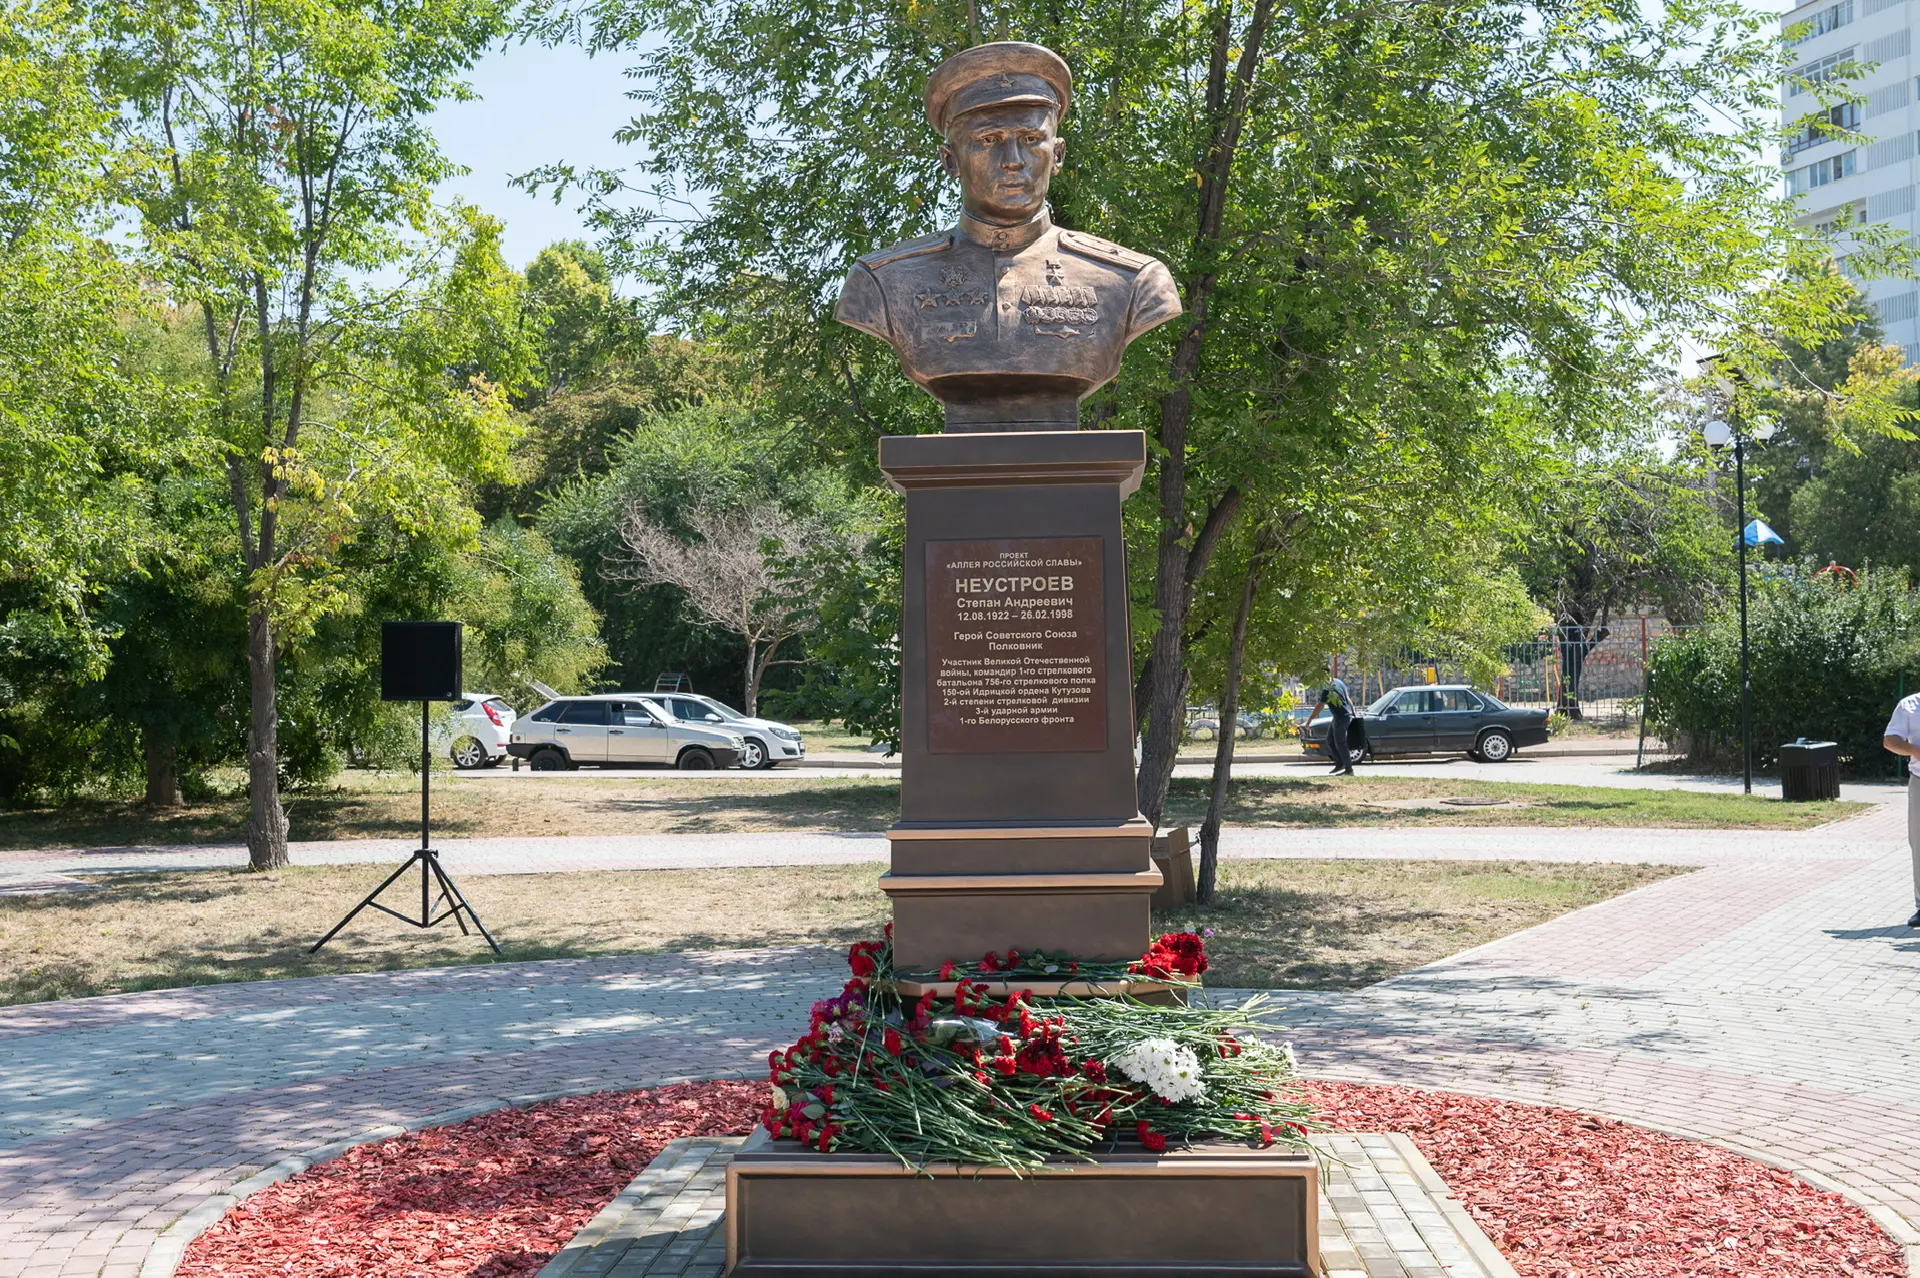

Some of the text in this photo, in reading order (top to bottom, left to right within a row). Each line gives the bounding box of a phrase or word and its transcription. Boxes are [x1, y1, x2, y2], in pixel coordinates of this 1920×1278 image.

[983, 559, 1044, 568] РОССИЙСКОЙ
[955, 576, 1074, 593] НЕУСТРОЕВ
[957, 597, 1073, 609] Степан Андреевич
[958, 611, 1009, 621] 12.08.1922
[1021, 609, 1073, 620] 26.02.1998
[954, 630, 1077, 642] Герой Советского Союза
[989, 642, 1043, 650] Полковник
[942, 656, 1090, 666] Участник Великой Отечественной
[940, 667, 1092, 677] войны, командир 1-го стрелкового
[1014, 677, 1068, 686] стрелкового
[973, 687, 1016, 697] Идрицкой
[1018, 688, 1049, 696] ордена
[1052, 687, 1091, 695] Кутузова
[944, 697, 1090, 706] 2-й степени стрелковой дивизии
[976, 706, 1058, 716] 3-й ударной армии
[960, 716, 1074, 725] 1-го Белорусского фронта
